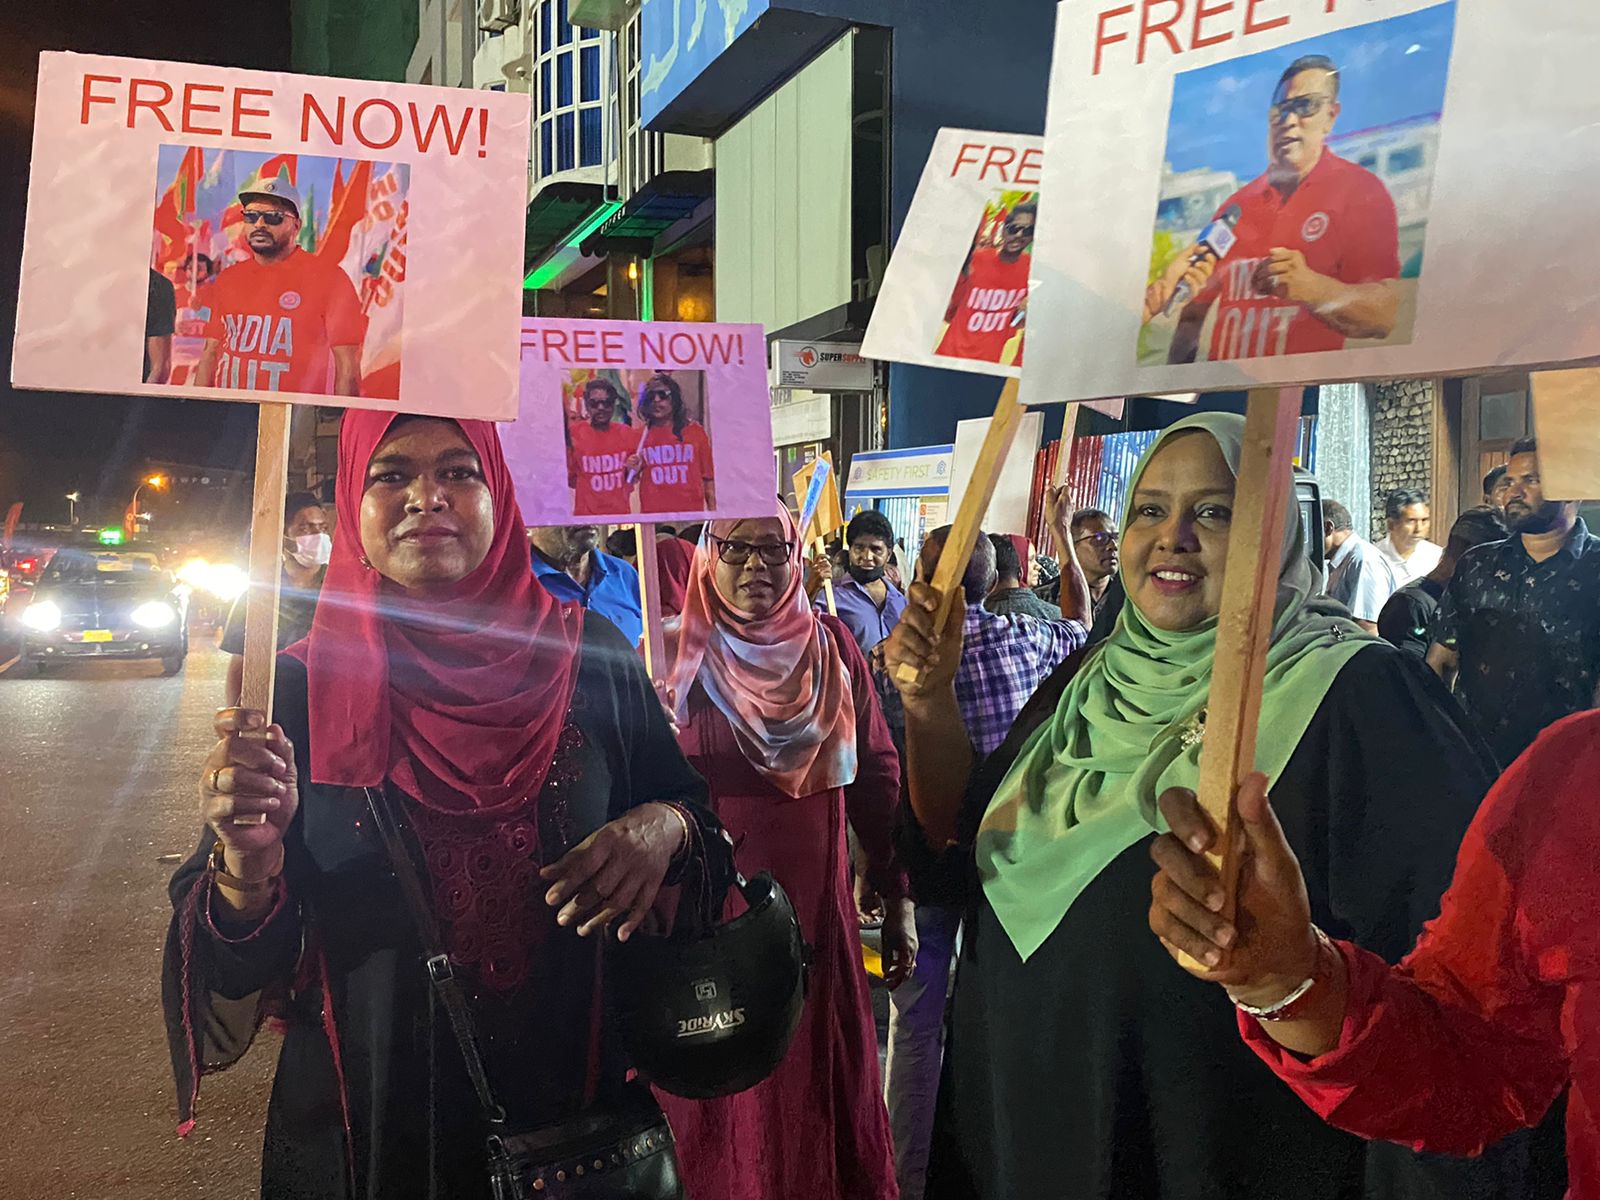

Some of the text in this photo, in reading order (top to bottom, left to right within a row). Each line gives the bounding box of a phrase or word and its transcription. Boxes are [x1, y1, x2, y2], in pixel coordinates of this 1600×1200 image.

[1092, 0, 1291, 76] FREE
[80, 74, 489, 159] FREE NOW!
[967, 311, 1011, 333] OUT
[520, 328, 745, 365] FREE NOW!
[643, 443, 694, 465] INDIA
[591, 471, 624, 493] OUT
[651, 465, 688, 485] OUT
[867, 464, 931, 481] SAFETY FIRST
